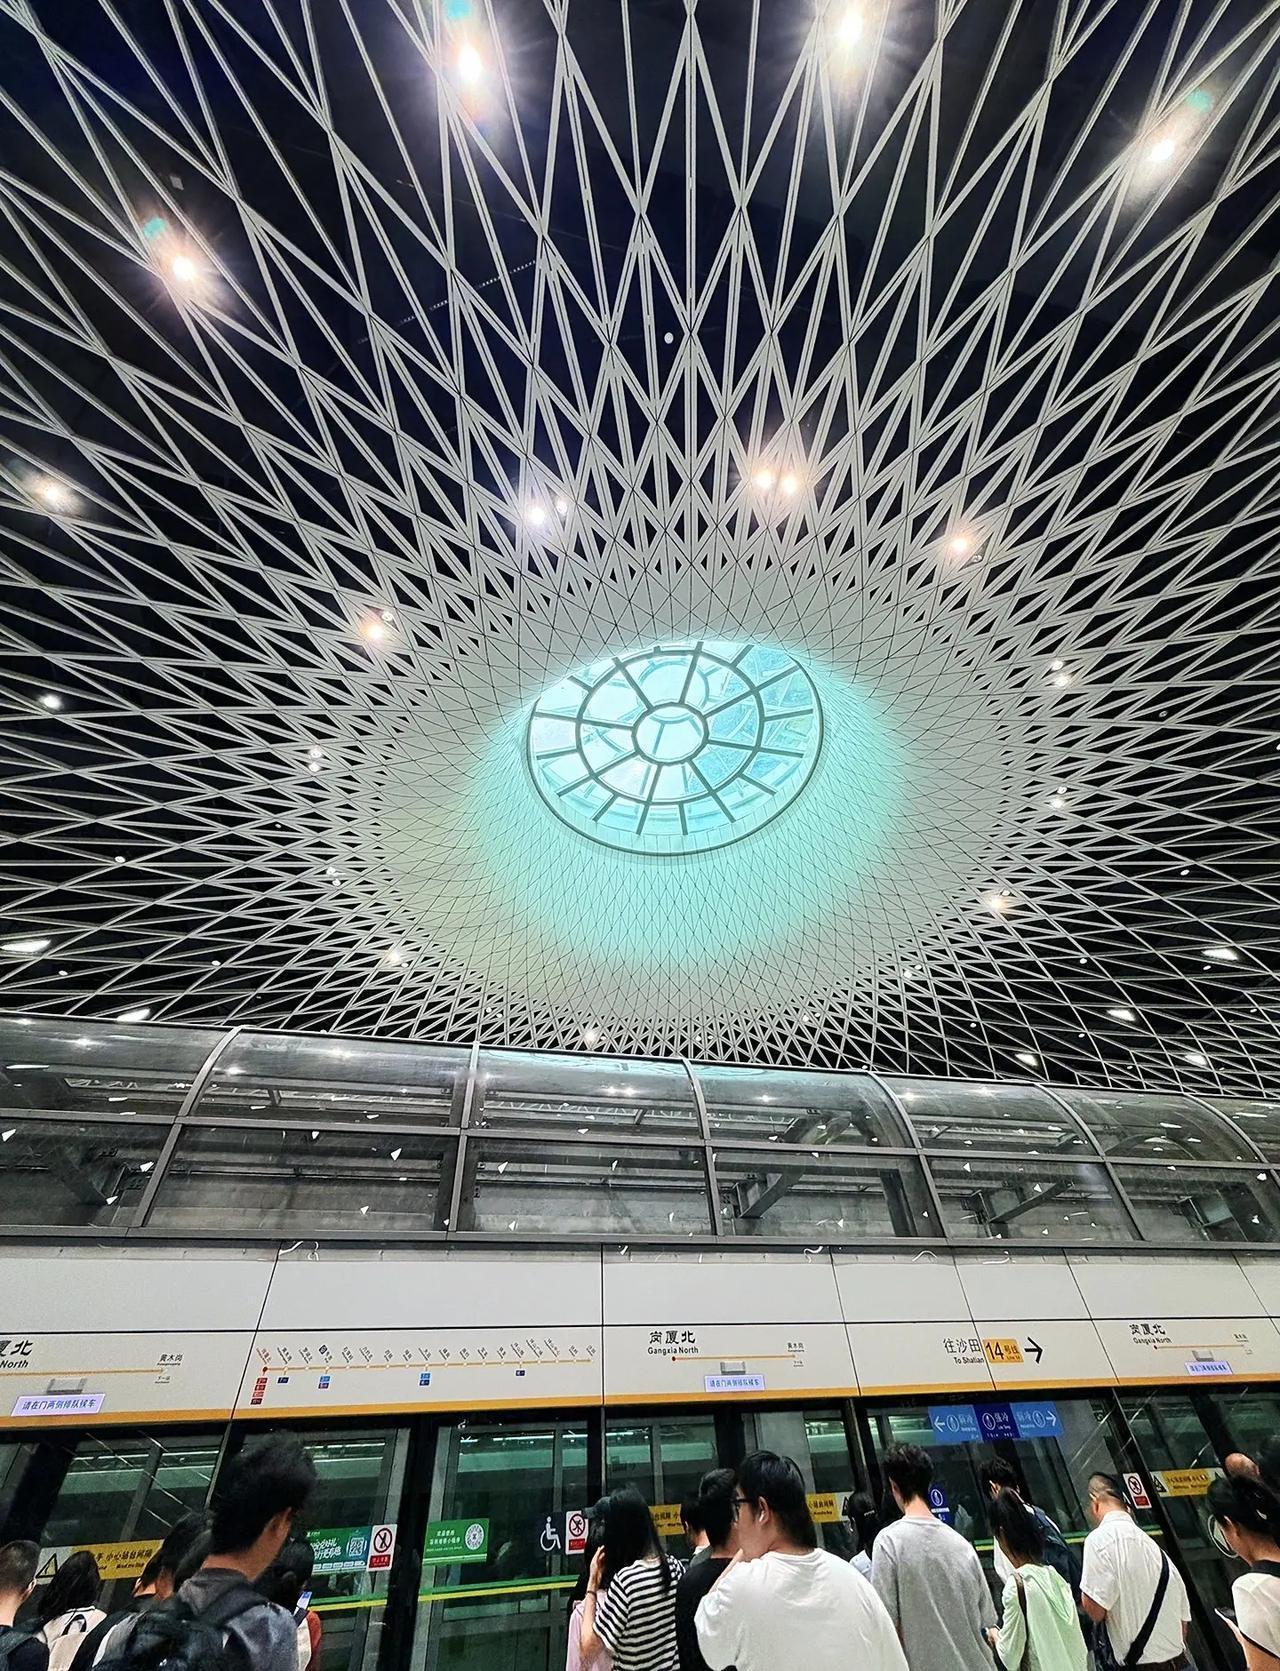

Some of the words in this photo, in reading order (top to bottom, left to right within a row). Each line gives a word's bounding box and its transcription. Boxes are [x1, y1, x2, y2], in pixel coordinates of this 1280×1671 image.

[649, 1330, 696, 1344] 岗厦北
[647, 1347, 677, 1356] Gangxia
[678, 1346, 699, 1354] North
[943, 1338, 981, 1354] 往沙田
[985, 1341, 1004, 1360] 14
[0, 1360, 29, 1369] North
[953, 1356, 962, 1364] To
